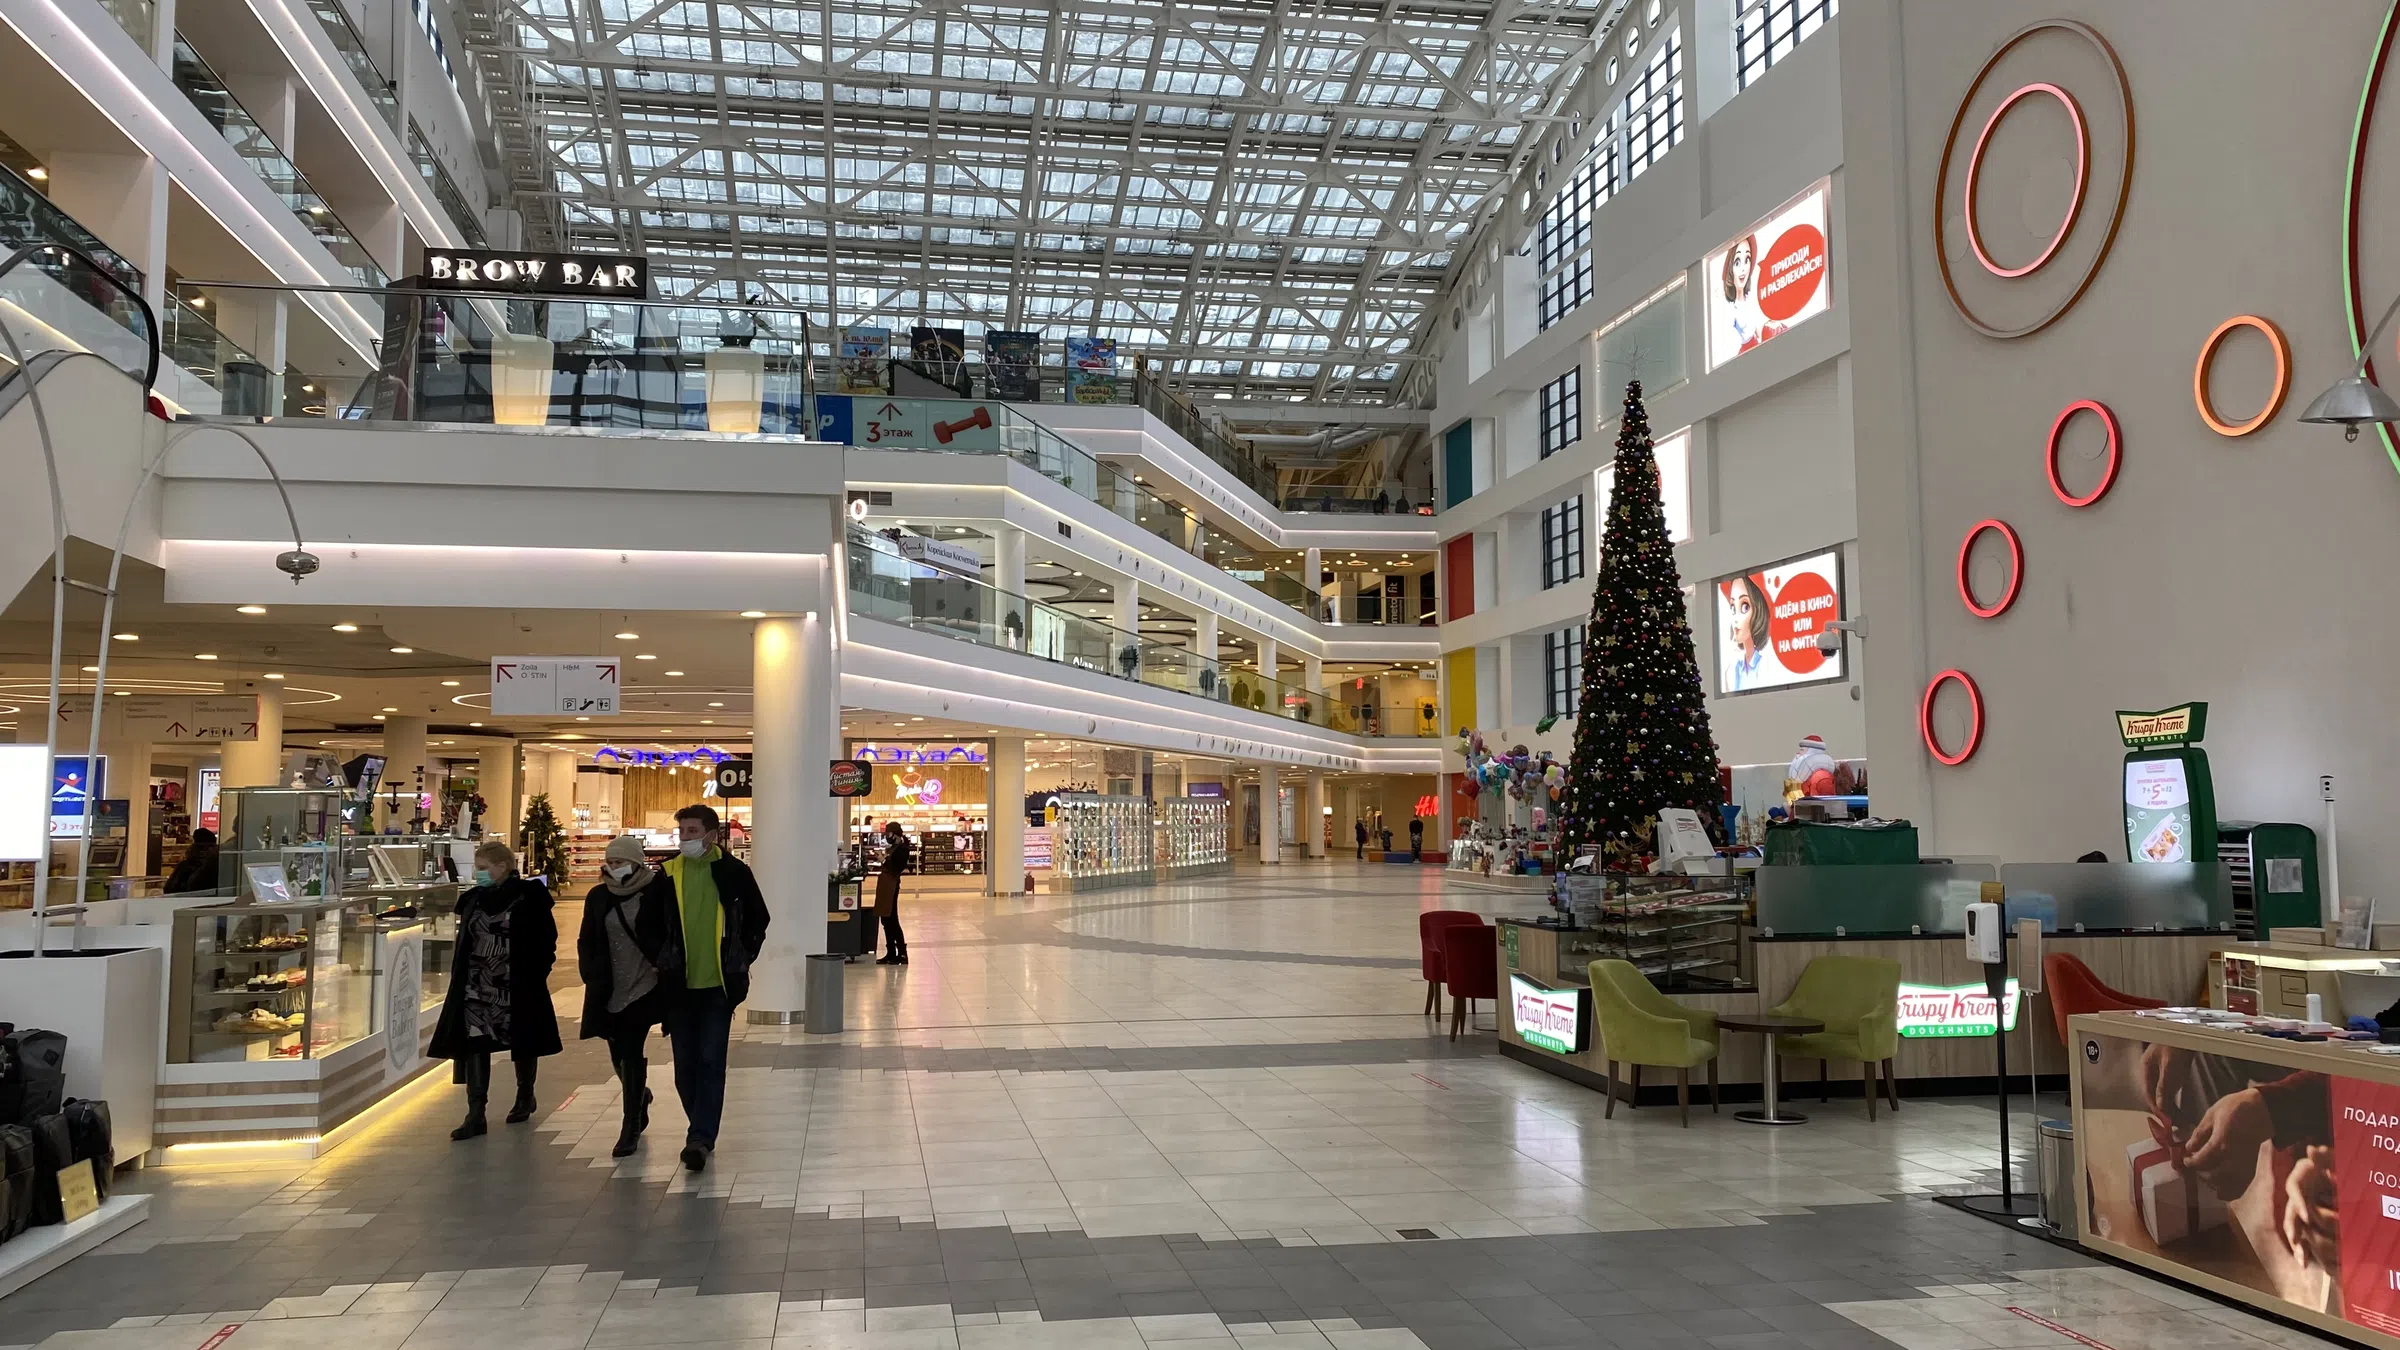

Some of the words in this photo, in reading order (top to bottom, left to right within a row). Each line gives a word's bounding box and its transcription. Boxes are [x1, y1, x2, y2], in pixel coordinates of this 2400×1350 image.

[1770, 244, 1810, 277] ПРИХОДИ
[430, 256, 547, 283] BROW
[562, 262, 639, 288] BAR
[1760, 286, 1767, 300] И
[1767, 254, 1823, 296] РАЗВЛЕКАЙСЯ!
[866, 421, 881, 443] 3
[883, 429, 913, 439] этаж
[1775, 601, 1799, 619] ИДЁМ
[1800, 600, 1807, 613] В
[1807, 594, 1833, 612] КИНО
[1793, 617, 1812, 632] ИЛИ
[1779, 639, 1791, 653] НА
[2126, 718, 2155, 736] Krispy
[2154, 715, 2185, 733] Kreme
[2127, 734, 2184, 744] DOUGHNUTS
[1517, 992, 1545, 1033] Krispy
[1544, 1000, 1575, 1035] Kreme
[1525, 1030, 1563, 1051] DOUGHNUTS
[1909, 1025, 1989, 1035] DOUGHNUTS
[2087, 1045, 2099, 1056] 18+
[2368, 1170, 2400, 1189] IQO
